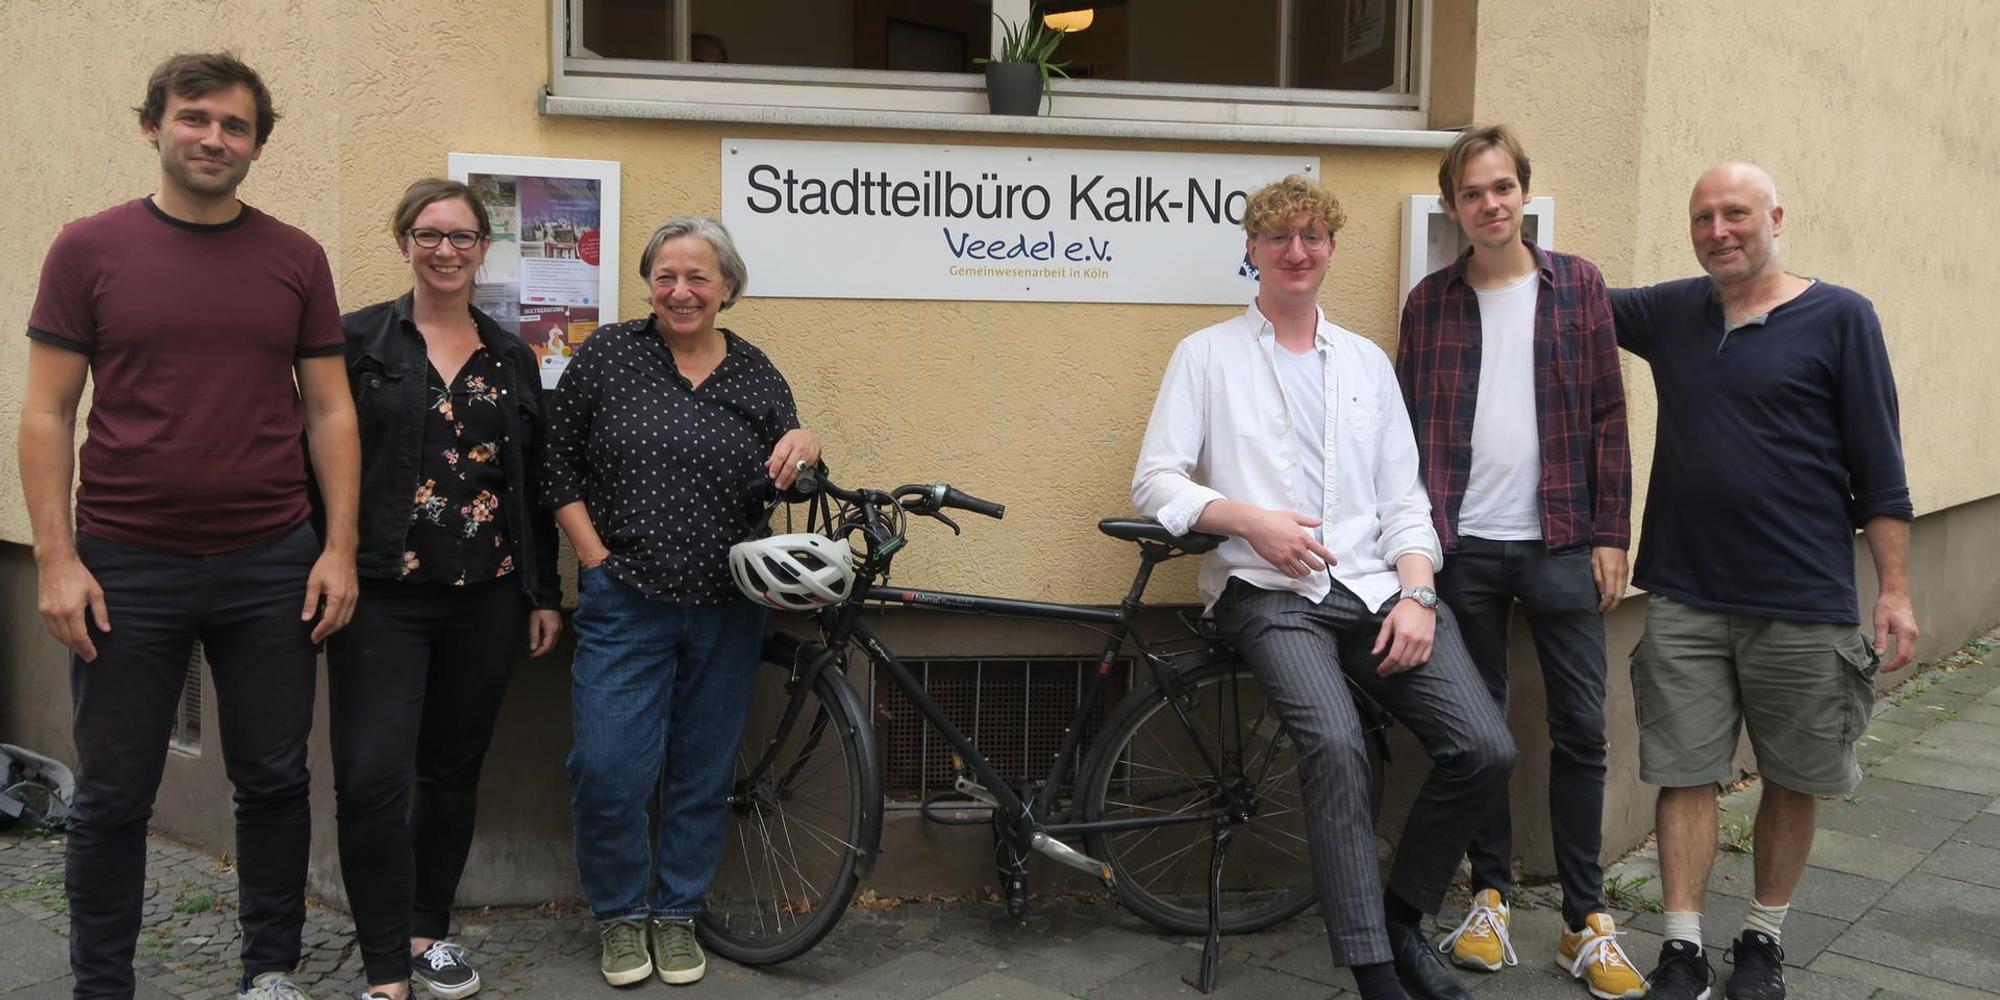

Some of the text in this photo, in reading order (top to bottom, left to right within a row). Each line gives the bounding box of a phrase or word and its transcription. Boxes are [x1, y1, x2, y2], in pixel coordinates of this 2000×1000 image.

[746, 164, 1248, 225] Stadtteilbüro Kalk-No
[943, 227, 1112, 262] Veedel e.V.
[949, 265, 1109, 279] Gemeinwesenarbeit in Köln
